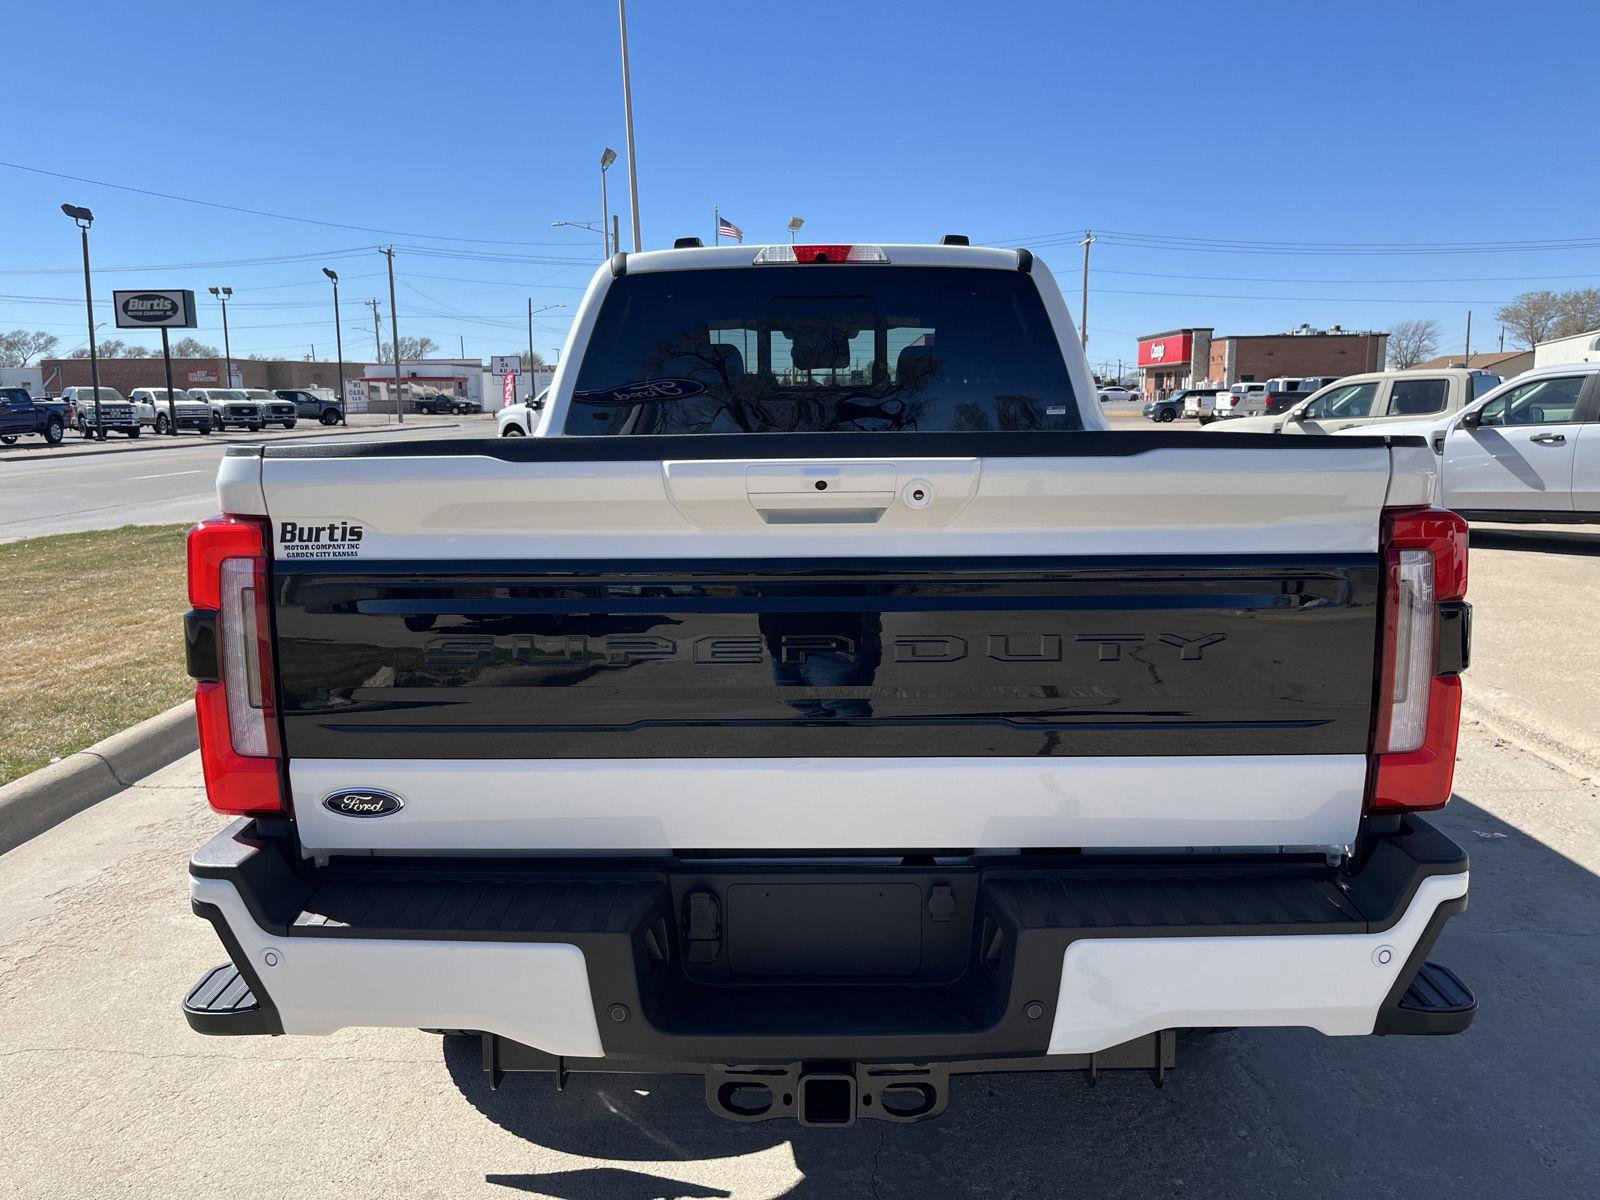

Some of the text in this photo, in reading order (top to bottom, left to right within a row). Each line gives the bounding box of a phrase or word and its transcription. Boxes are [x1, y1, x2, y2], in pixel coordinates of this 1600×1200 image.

[128, 298, 172, 310] Burtis
[280, 521, 363, 543] Burtis
[424, 632, 1227, 667] SUPER DUTY
[341, 795, 384, 812] Ford
